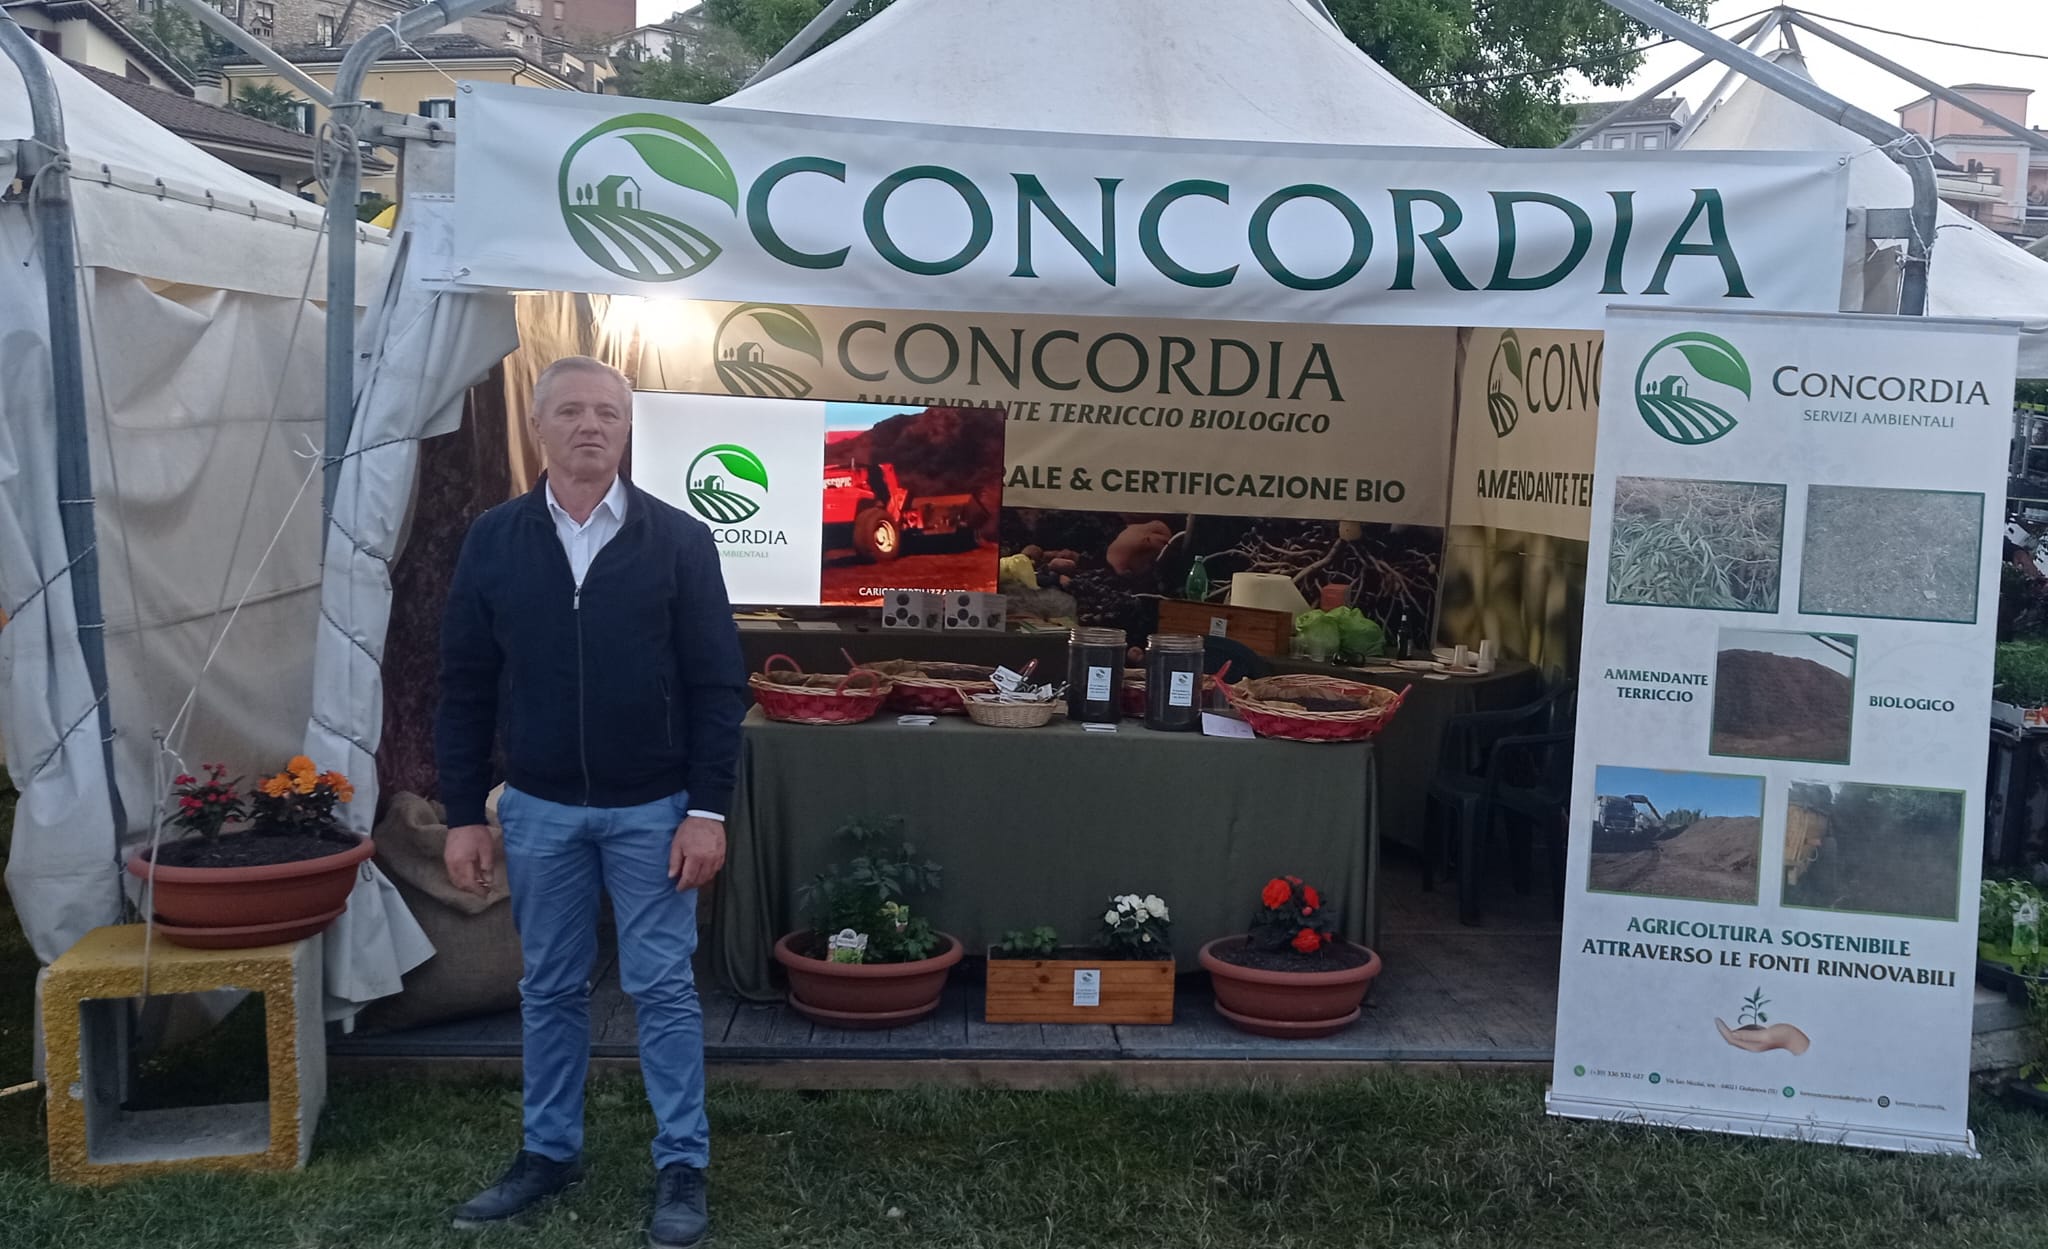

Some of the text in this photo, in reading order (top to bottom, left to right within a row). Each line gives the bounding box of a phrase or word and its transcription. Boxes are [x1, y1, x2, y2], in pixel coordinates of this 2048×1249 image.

[745, 155, 1755, 298] CONCORDIA
[836, 319, 1346, 402] CONCORDIA
[1772, 365, 1990, 405] CONCORDIA
[1049, 402, 1184, 427] TERRICCIO
[1189, 408, 1331, 433] BIOLOGICO
[1803, 409, 1954, 429] SERVIZI AMBIENTALI
[1070, 467, 1093, 492] &
[1100, 468, 1348, 501] CERTIFICAZIONE
[1355, 478, 1406, 504] BIO
[1477, 469, 1569, 505] AMENDANTE
[1604, 668, 1708, 686] AMMENDANTE
[1617, 686, 1694, 703] TERRICCIO
[1869, 695, 1955, 713] BIOLOGICO
[1627, 916, 1911, 957] AGRICOLTURA SOSTENIBILE
[1582, 938, 1956, 987] ATTRAVERSO LE FONTI RINNOVABILI
